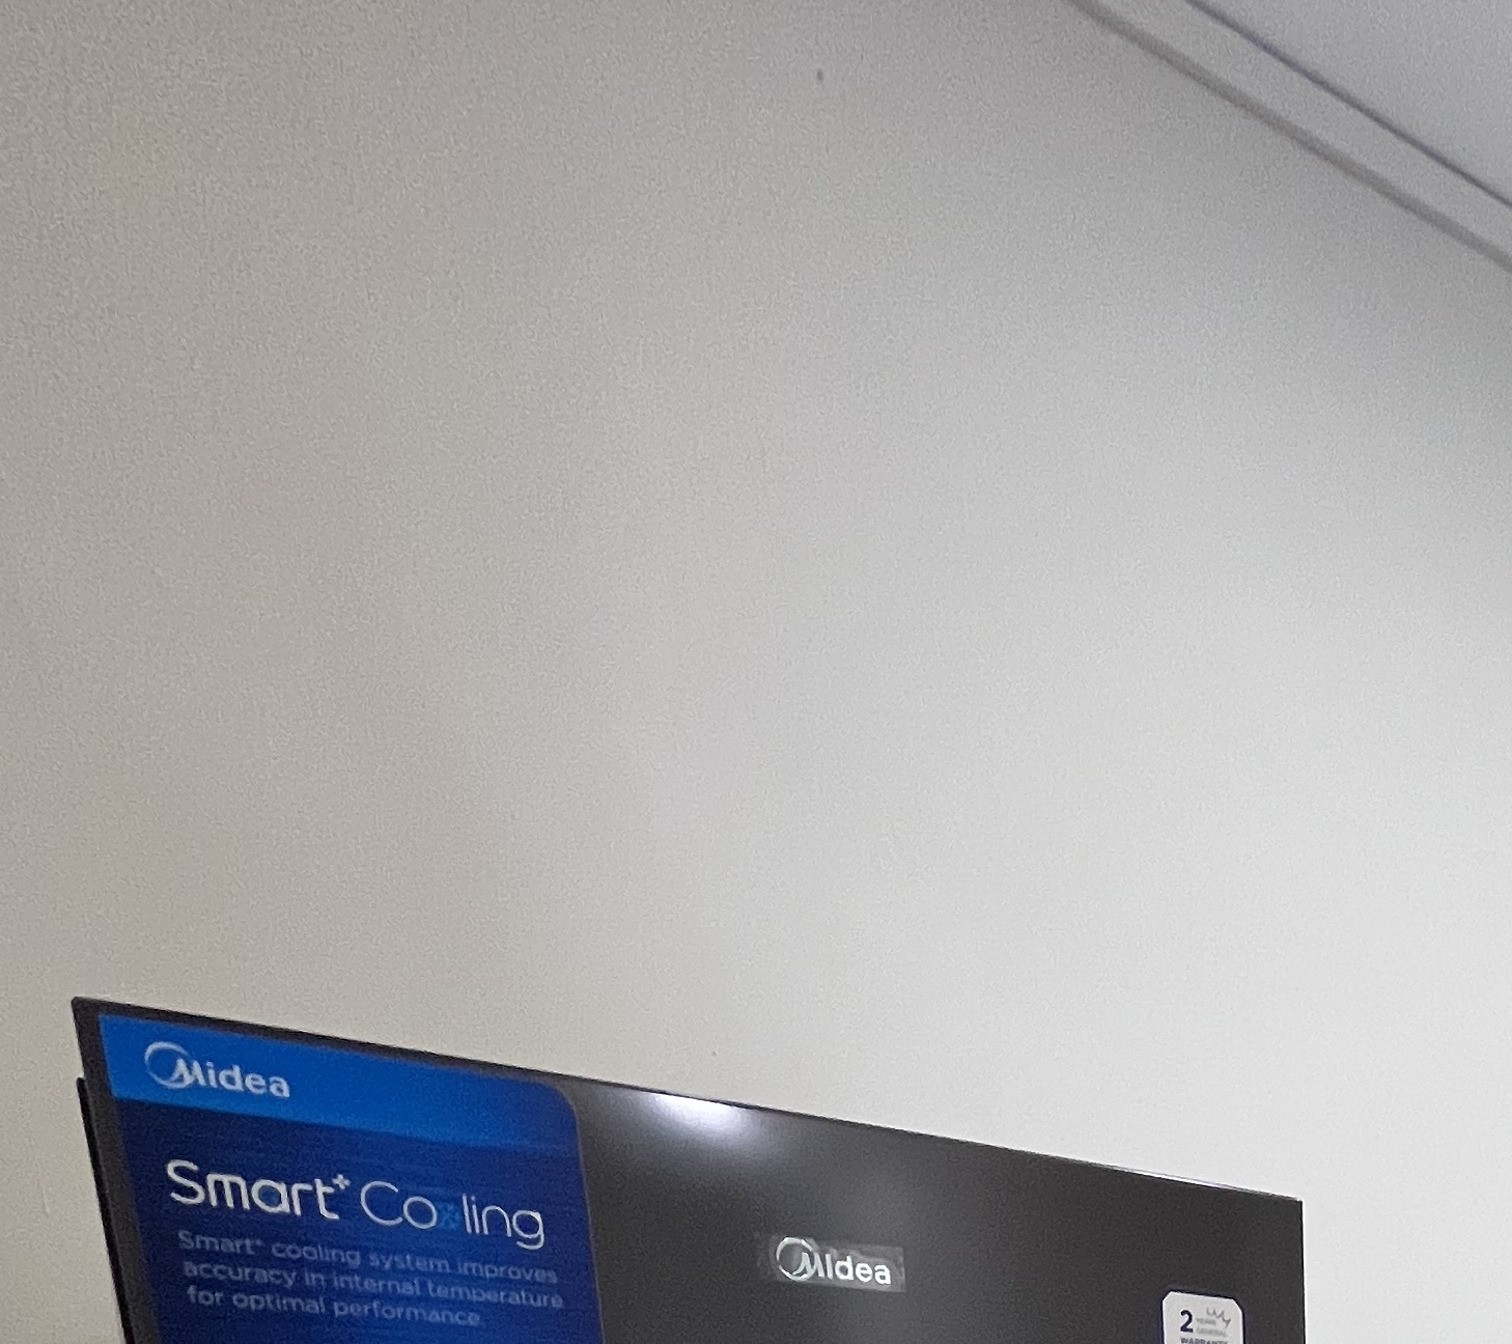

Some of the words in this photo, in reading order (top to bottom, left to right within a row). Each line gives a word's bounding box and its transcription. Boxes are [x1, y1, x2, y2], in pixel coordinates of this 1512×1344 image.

[144, 1041, 291, 1099] Midea
[272, 1243, 361, 1269] cooling
[369, 1250, 450, 1271] system
[457, 1260, 558, 1284] improves
[775, 1236, 892, 1285] Midea
[184, 1261, 296, 1288] accuracy
[305, 1270, 326, 1287] in
[334, 1271, 422, 1297] internal
[428, 1278, 564, 1309] temperature
[187, 1285, 224, 1306] for
[232, 1293, 326, 1314] optimal
[1180, 1309, 1194, 1333] 2
